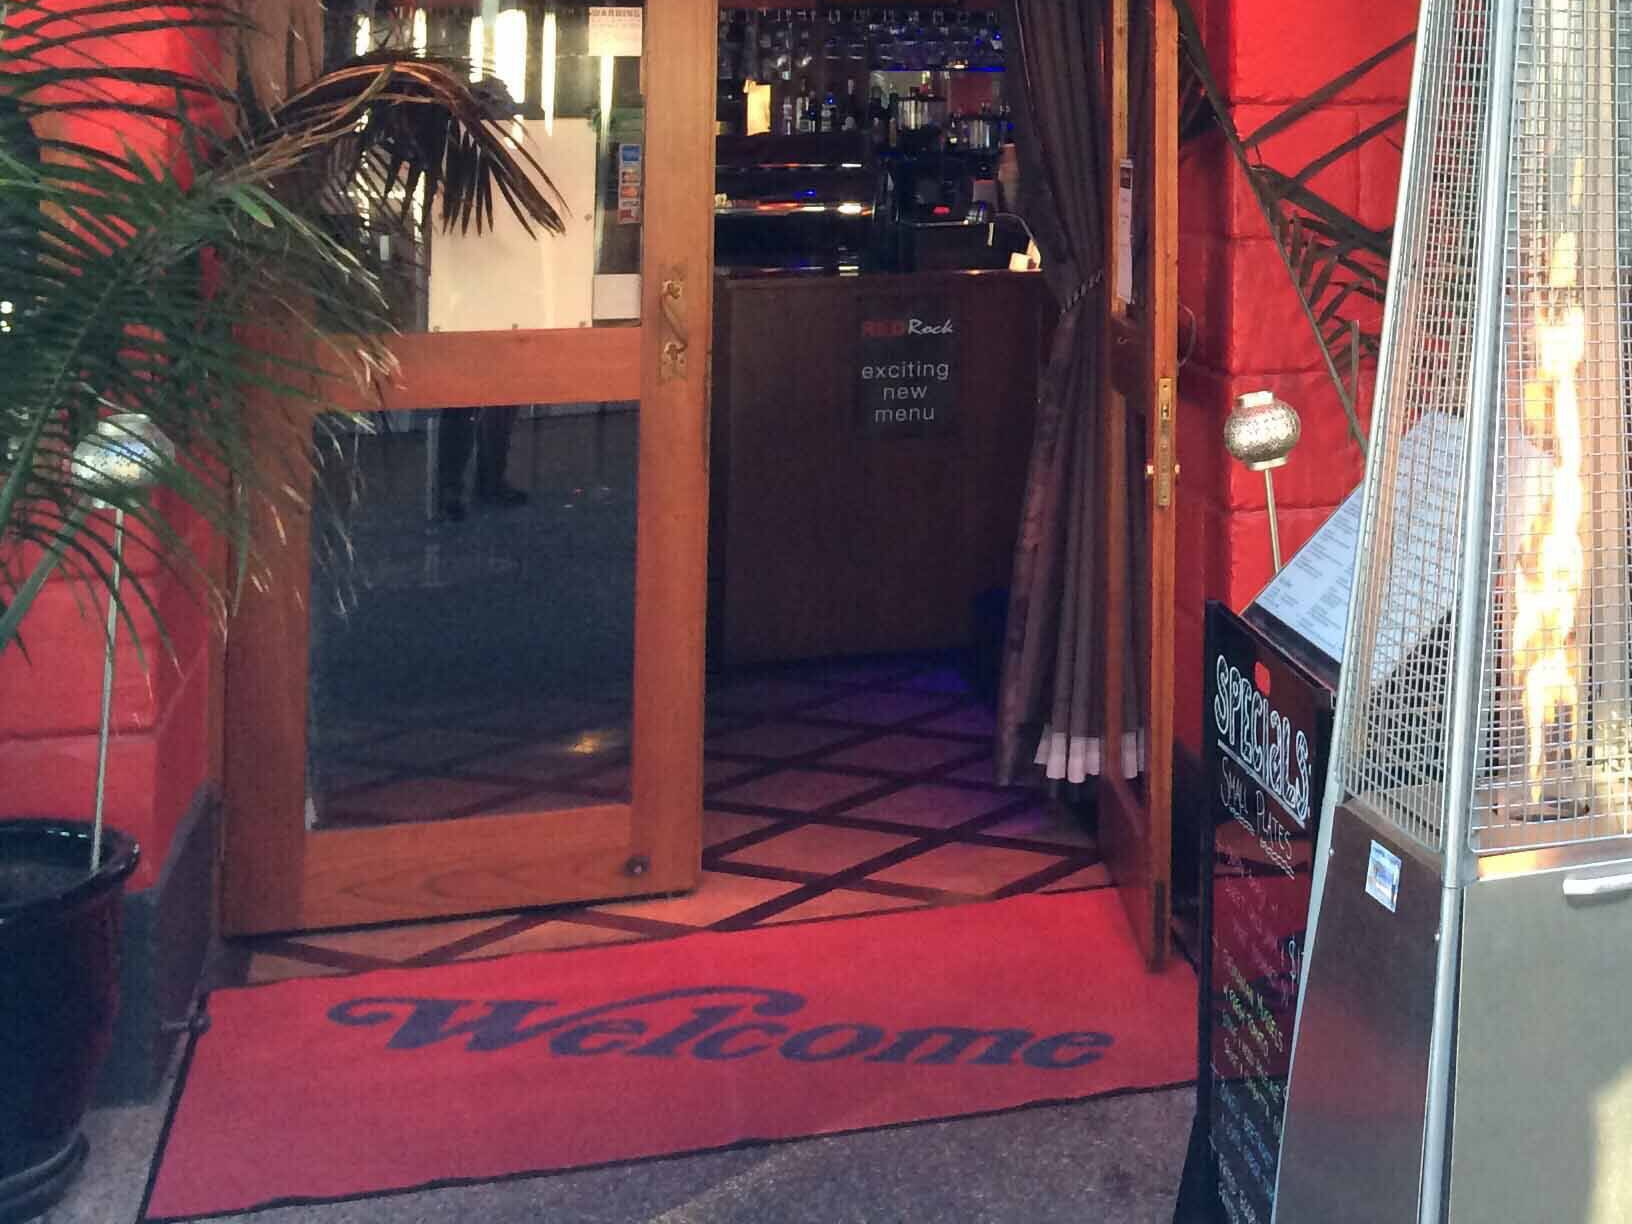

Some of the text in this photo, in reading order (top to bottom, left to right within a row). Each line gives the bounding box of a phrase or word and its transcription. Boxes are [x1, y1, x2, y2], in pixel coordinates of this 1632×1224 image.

[907, 318, 953, 335] Rock
[861, 361, 950, 381] exciting
[883, 385, 928, 401] new
[875, 407, 935, 424] menu
[326, 985, 1116, 1069] Welcome
